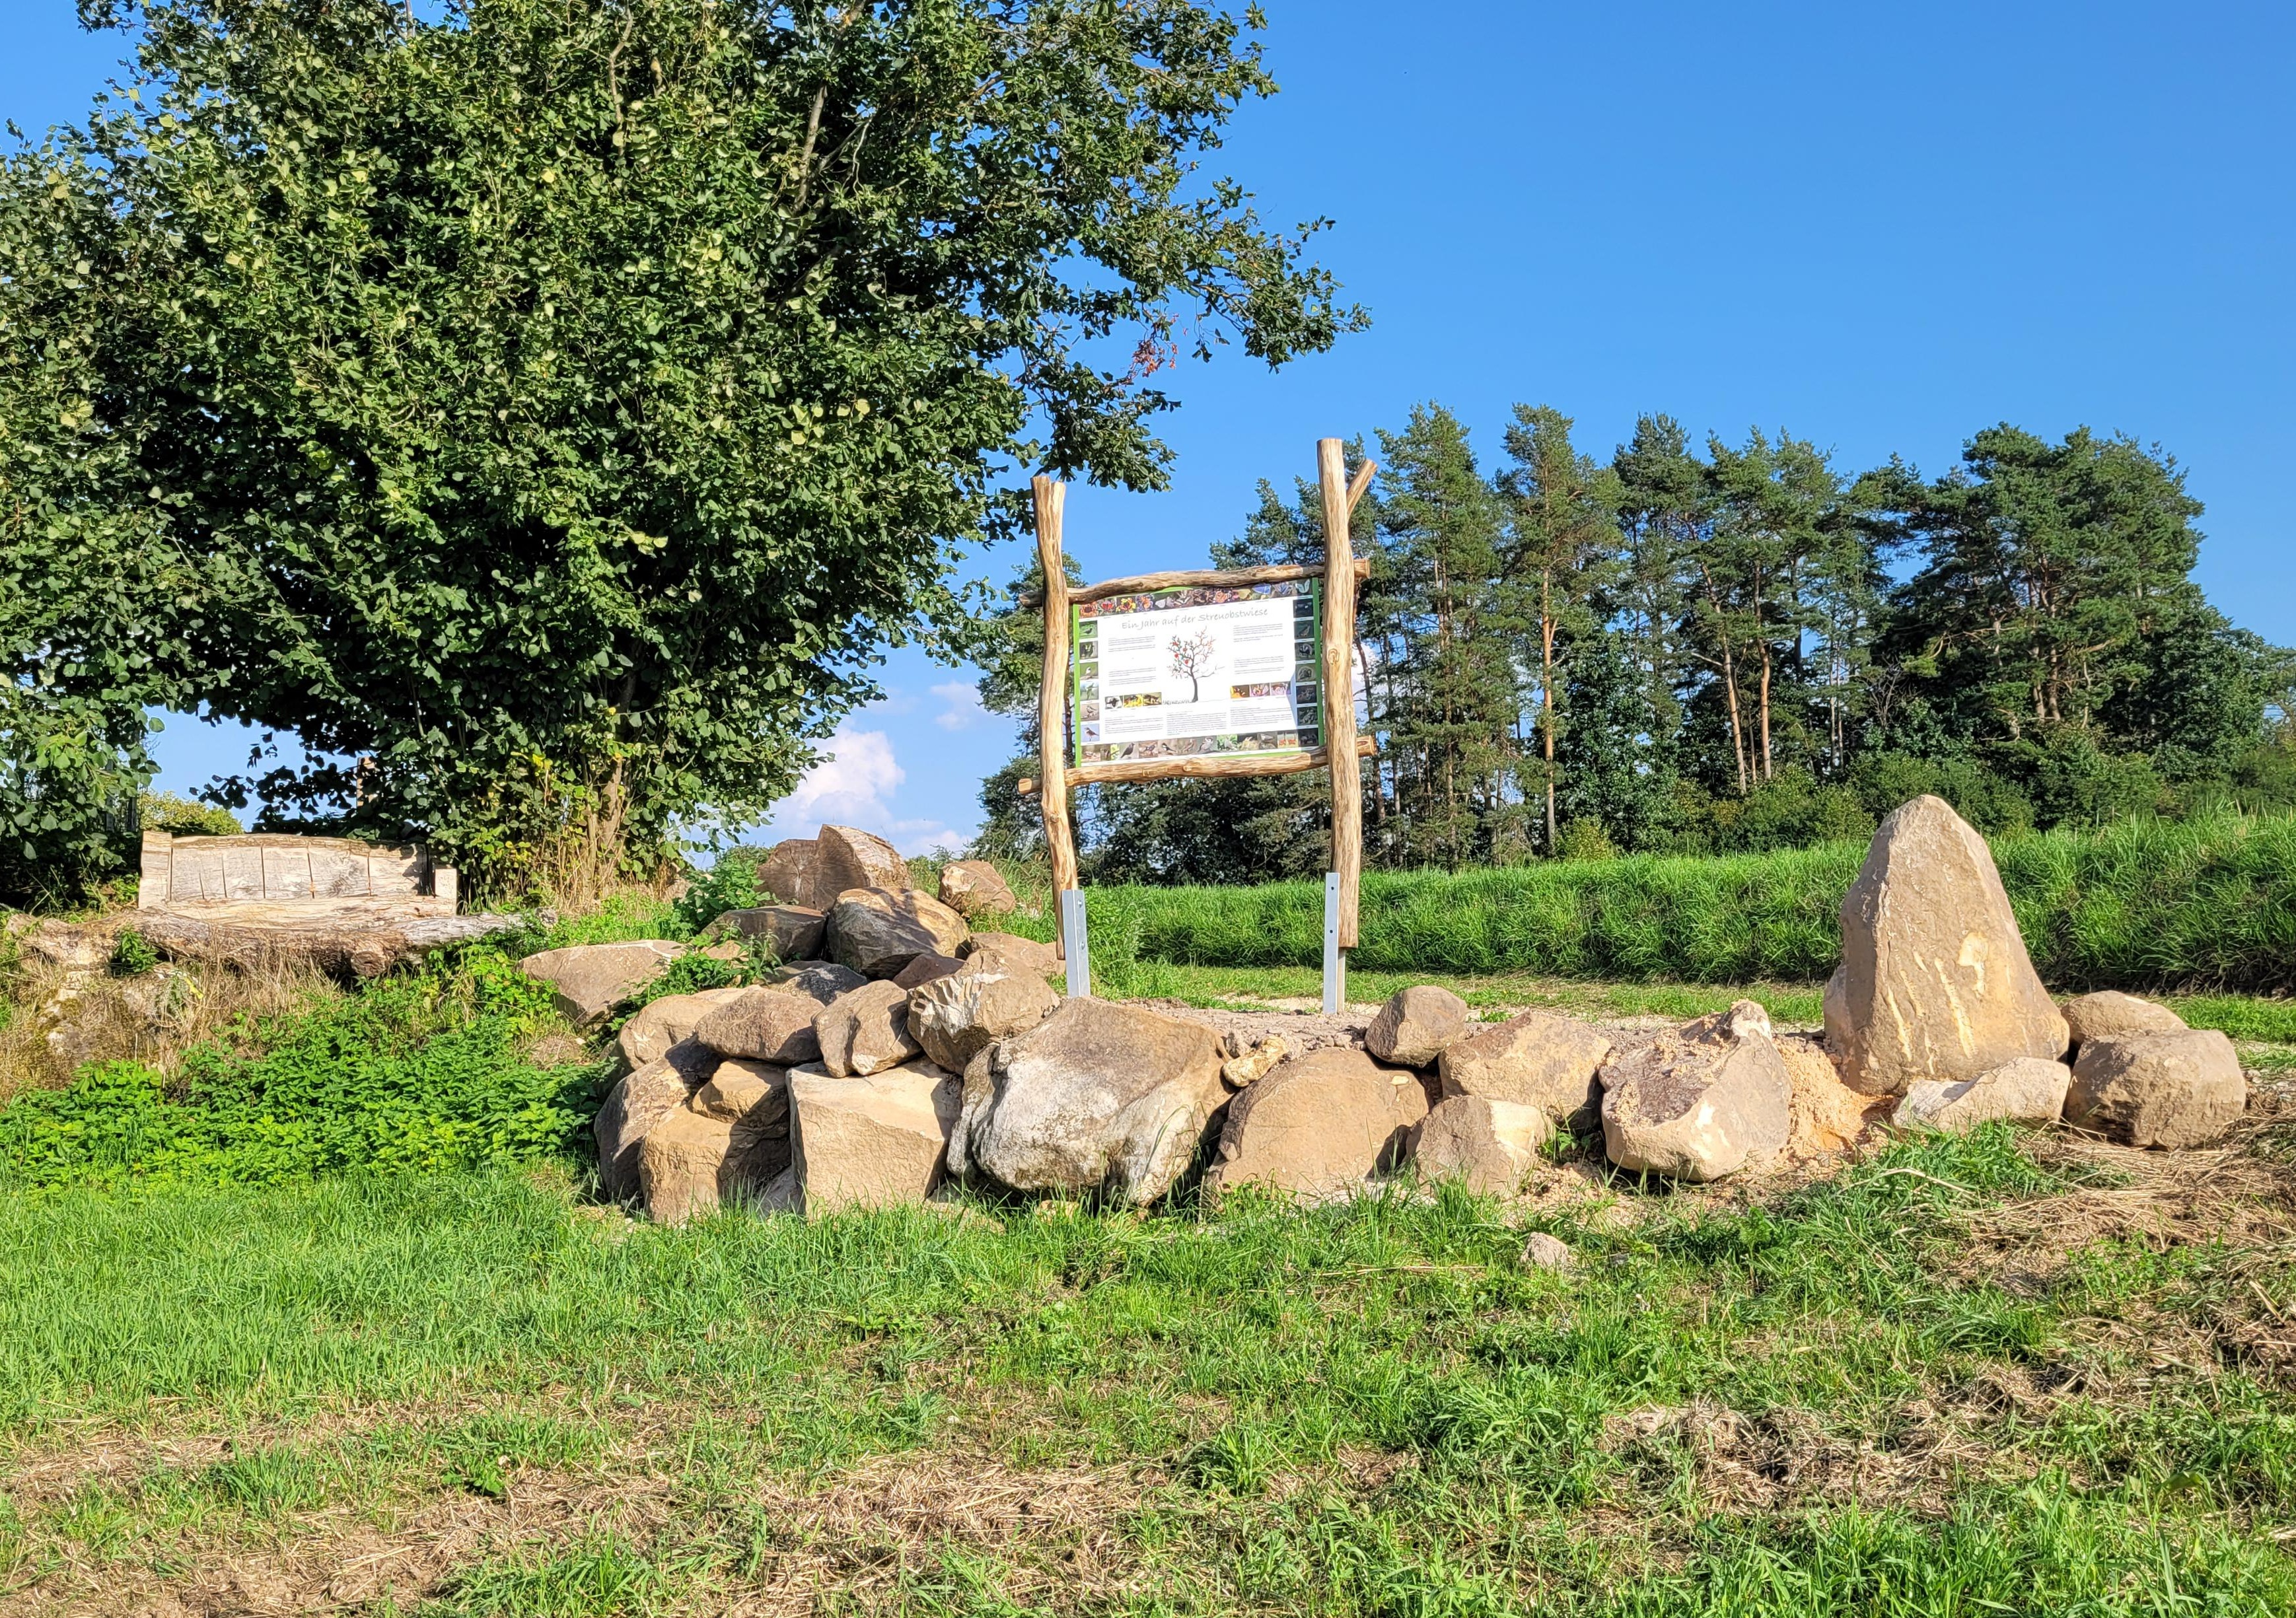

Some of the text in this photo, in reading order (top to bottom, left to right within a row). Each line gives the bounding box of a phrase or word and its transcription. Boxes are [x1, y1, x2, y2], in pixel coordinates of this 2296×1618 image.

[1122, 620, 1137, 629] Ein
[1137, 619, 1159, 630] Jahr
[1162, 615, 1180, 626] auf
[1181, 614, 1195, 623] der
[1198, 608, 1268, 621] Streuobstwiese
